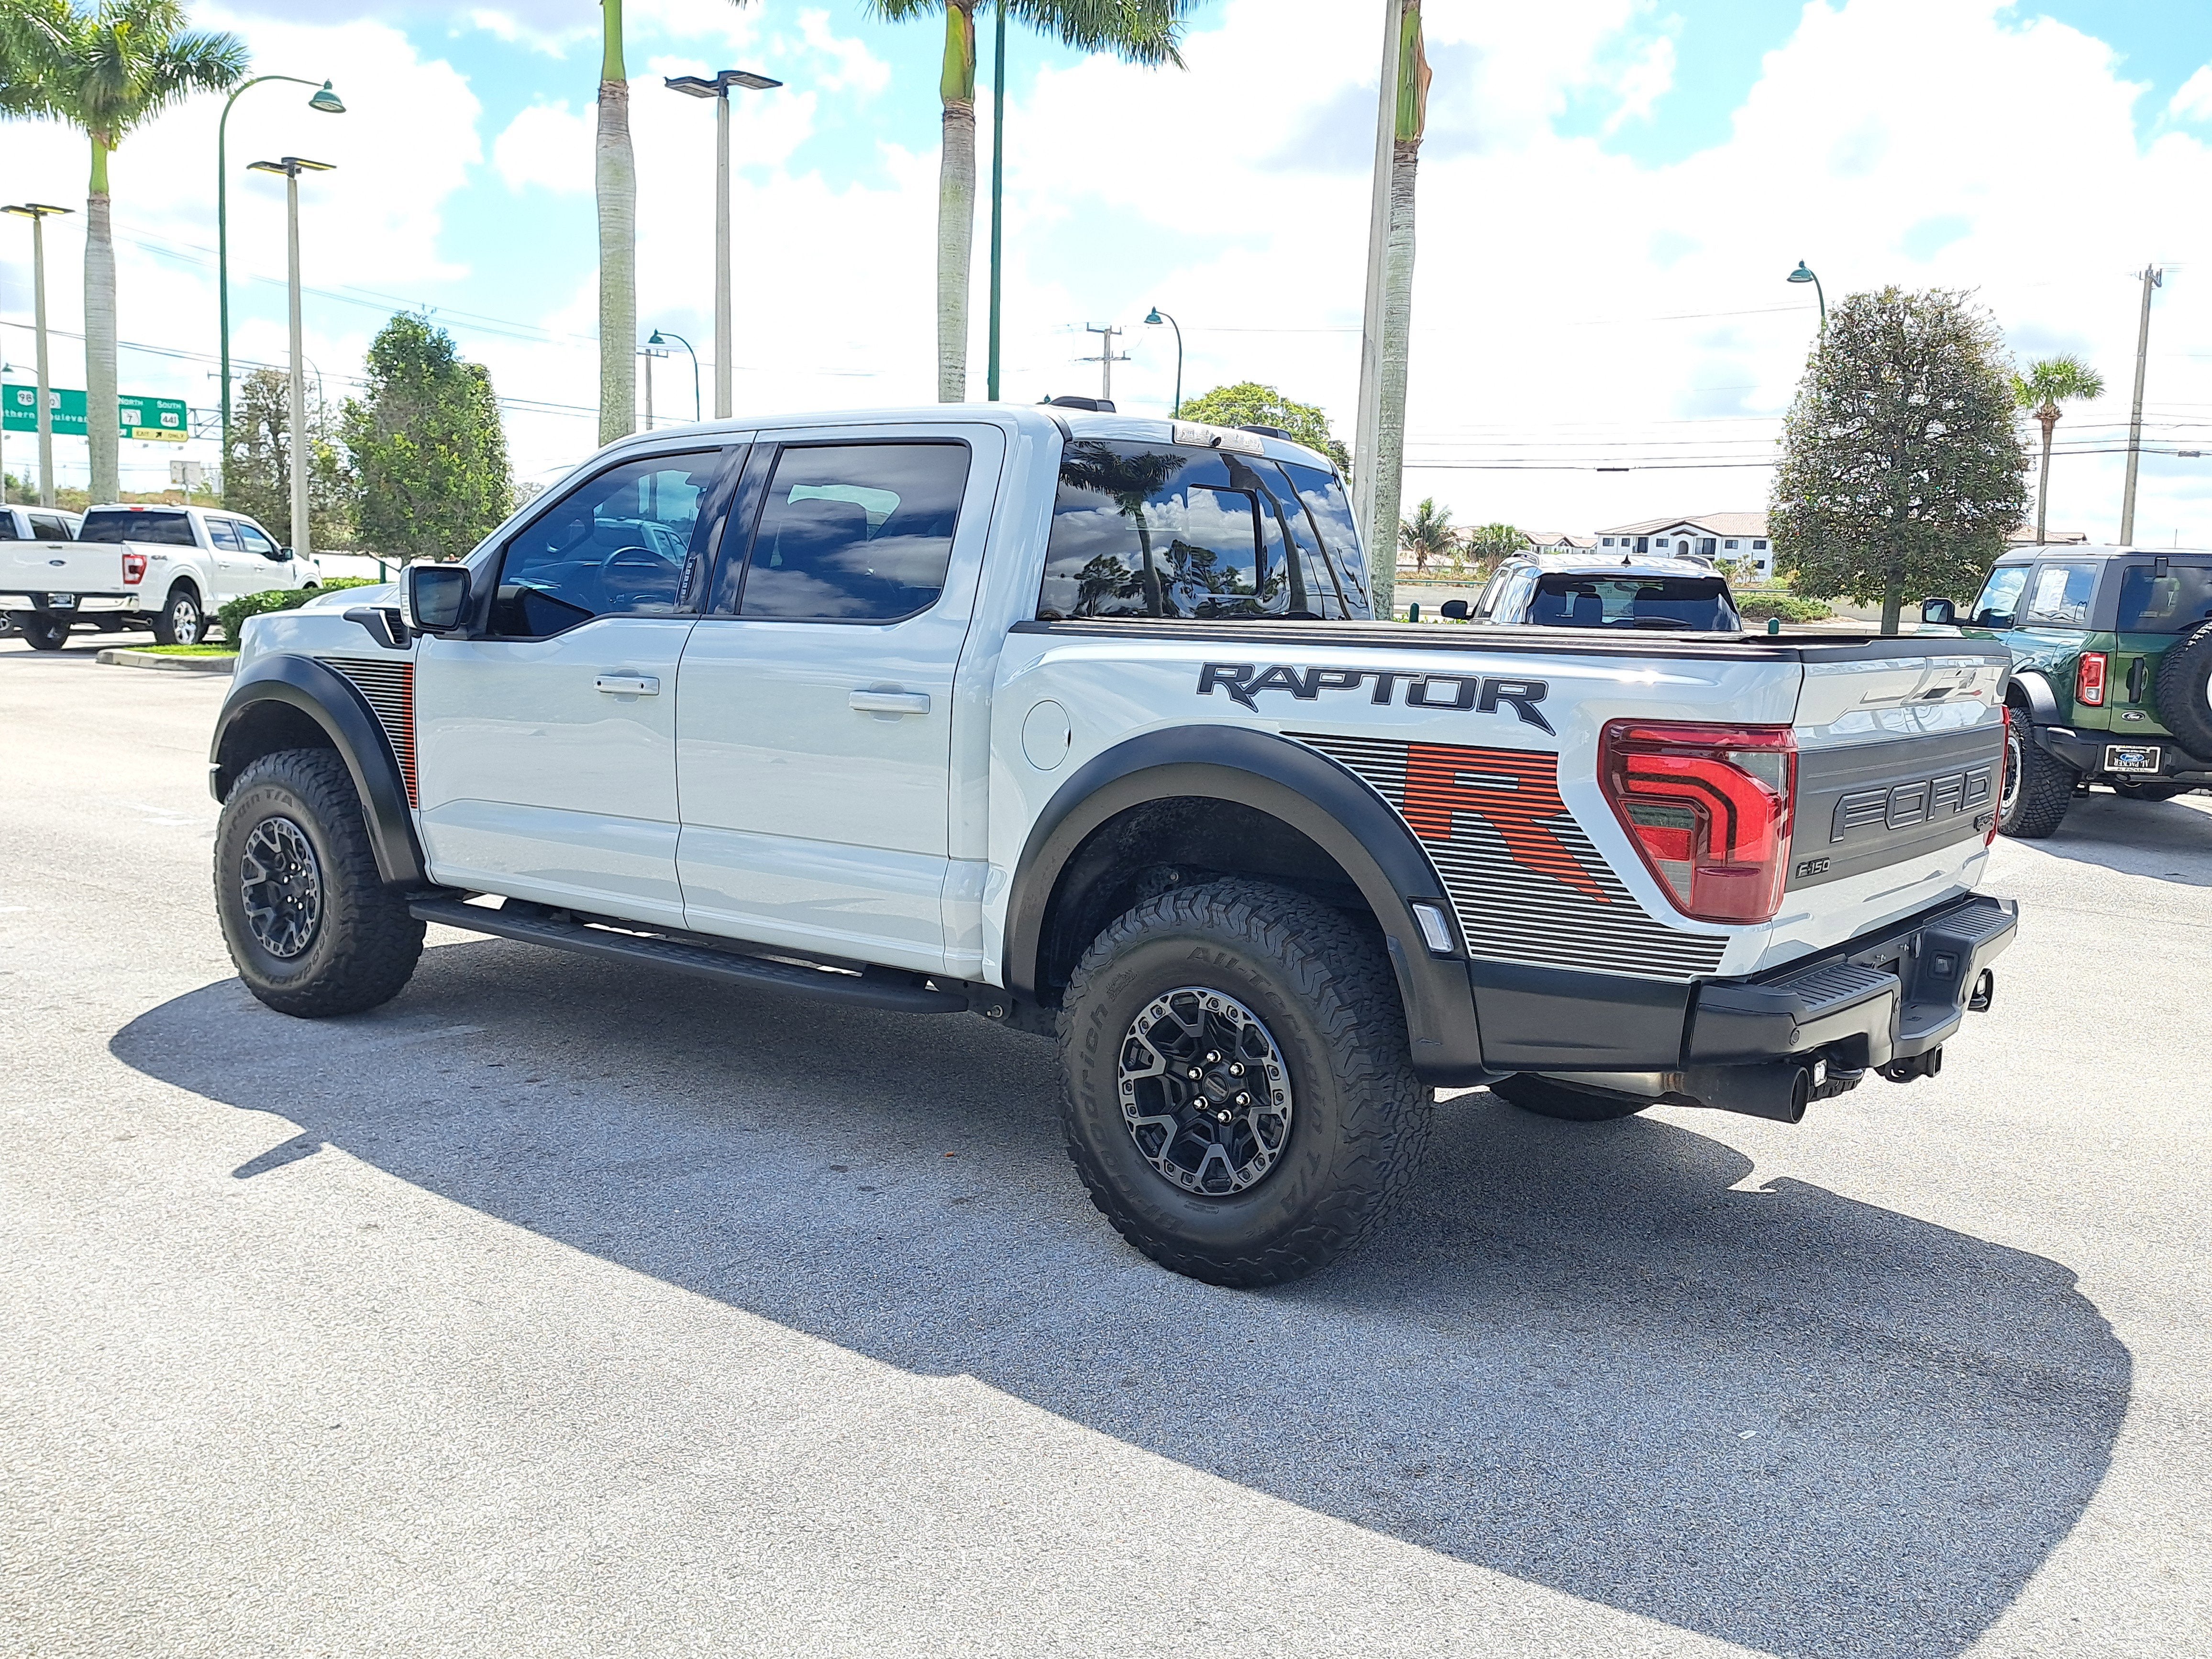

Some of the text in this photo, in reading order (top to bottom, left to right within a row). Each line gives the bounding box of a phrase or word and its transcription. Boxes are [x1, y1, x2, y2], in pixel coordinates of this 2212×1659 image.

[156, 400, 182, 409] SOUTH
[4, 409, 36, 419] thern
[163, 415, 177, 423] 441
[1196, 662, 1556, 736] RAPTOR
[2114, 757, 2150, 767] AL PACKER
[1829, 765, 1992, 844] FORD
[1797, 858, 1830, 877] F-150
